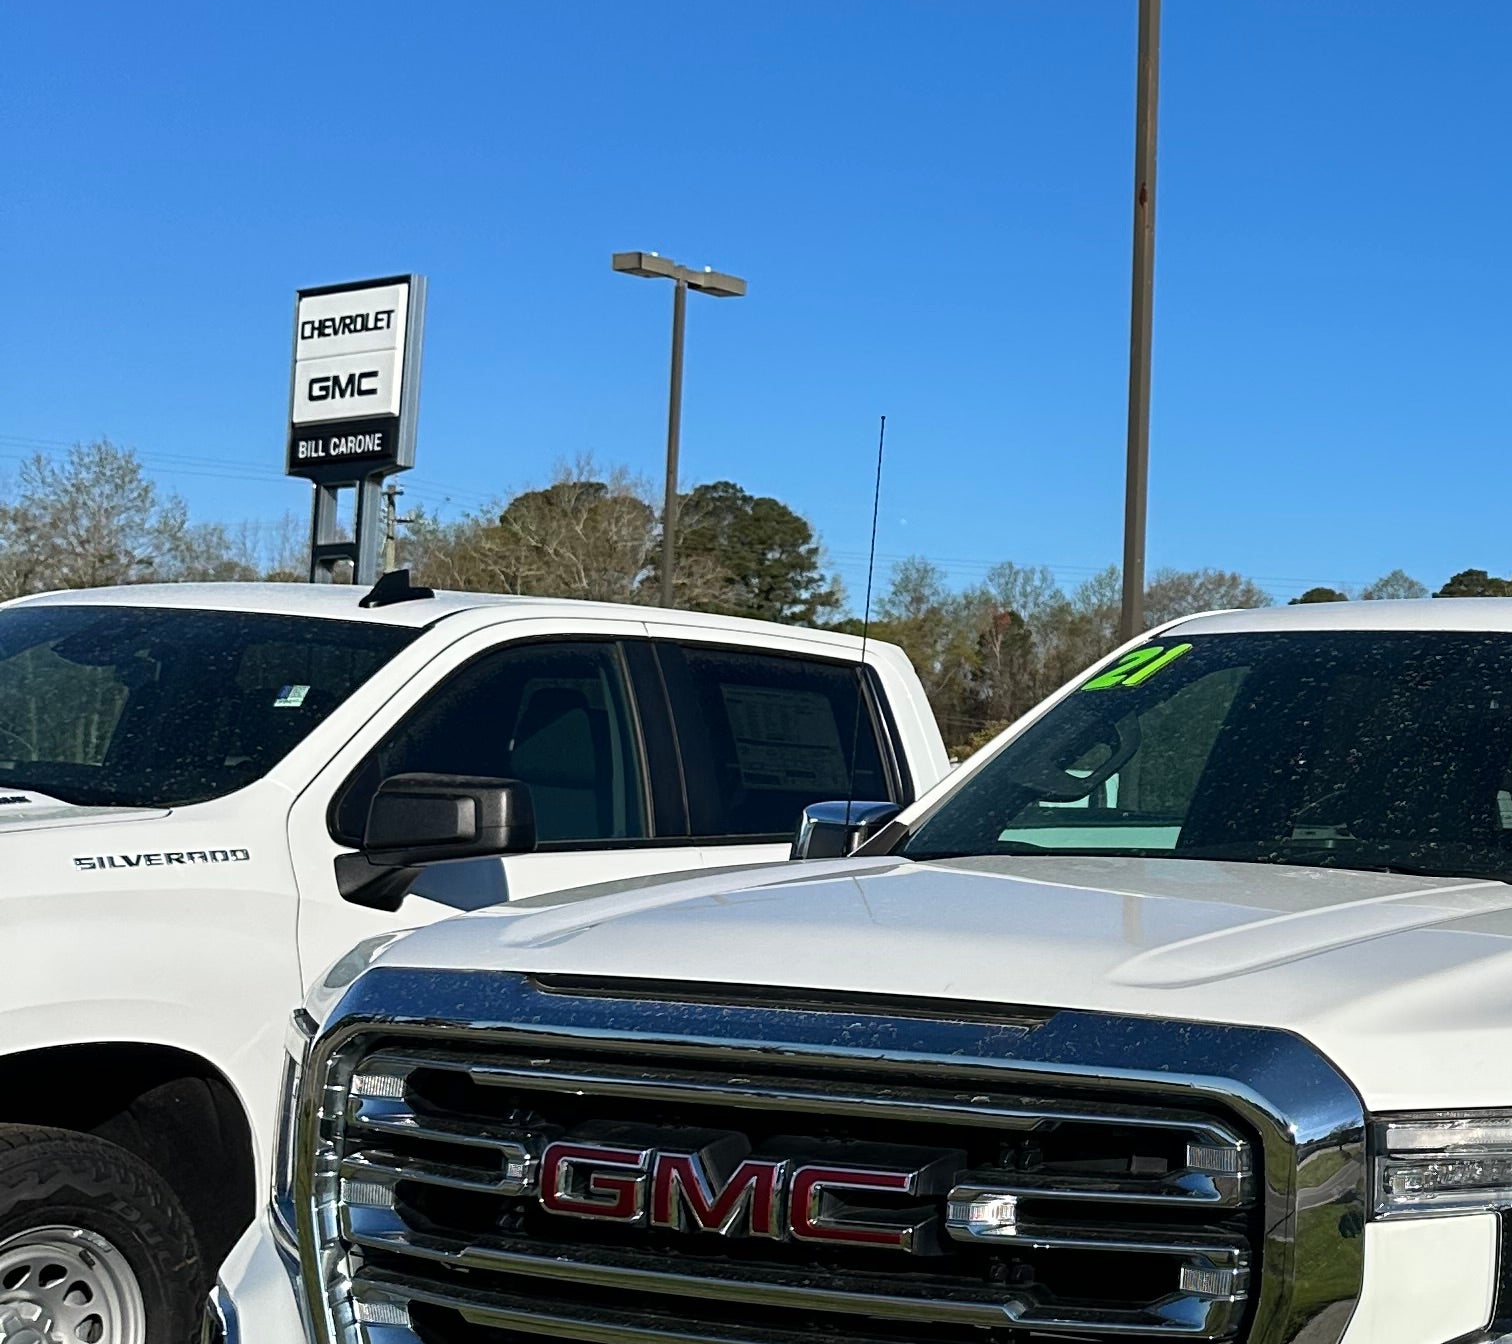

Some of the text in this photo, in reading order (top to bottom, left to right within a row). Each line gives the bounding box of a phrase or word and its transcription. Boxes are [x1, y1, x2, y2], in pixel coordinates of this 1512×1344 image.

[301, 309, 395, 340] CHEVROLET
[308, 370, 379, 402] GMC
[298, 433, 383, 459] BILL CARONE
[1081, 643, 1193, 692] 21
[73, 848, 250, 871] SILVERADO
[539, 1141, 916, 1253] GMC
